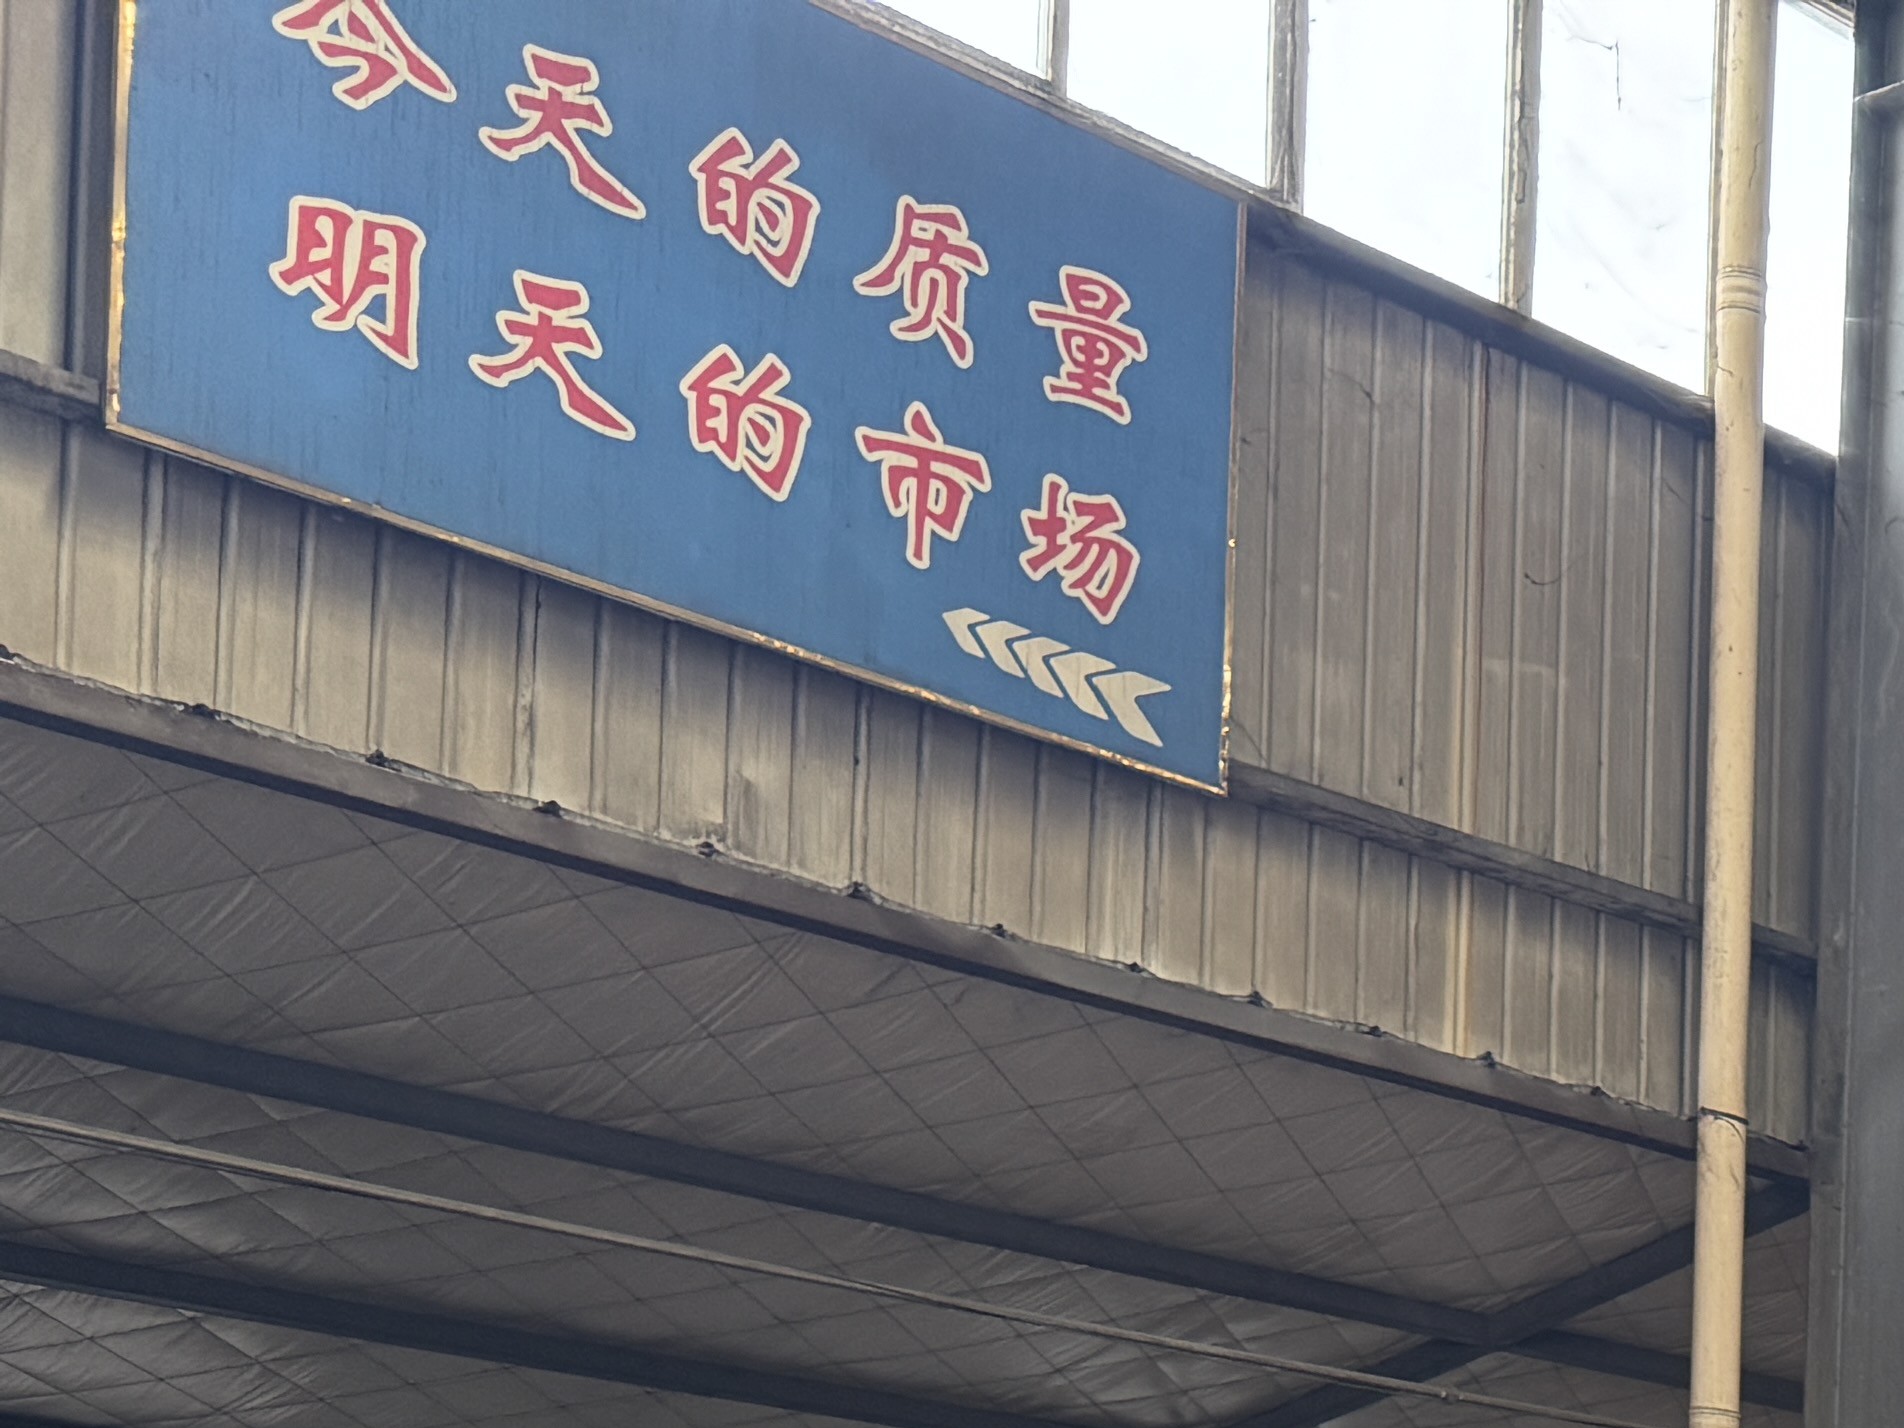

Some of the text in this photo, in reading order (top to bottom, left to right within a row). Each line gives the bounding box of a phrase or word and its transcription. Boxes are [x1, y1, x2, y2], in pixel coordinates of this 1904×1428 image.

[269, 196, 1141, 626] 明天的市场
[271, 0, 1147, 425] 今天的质量
